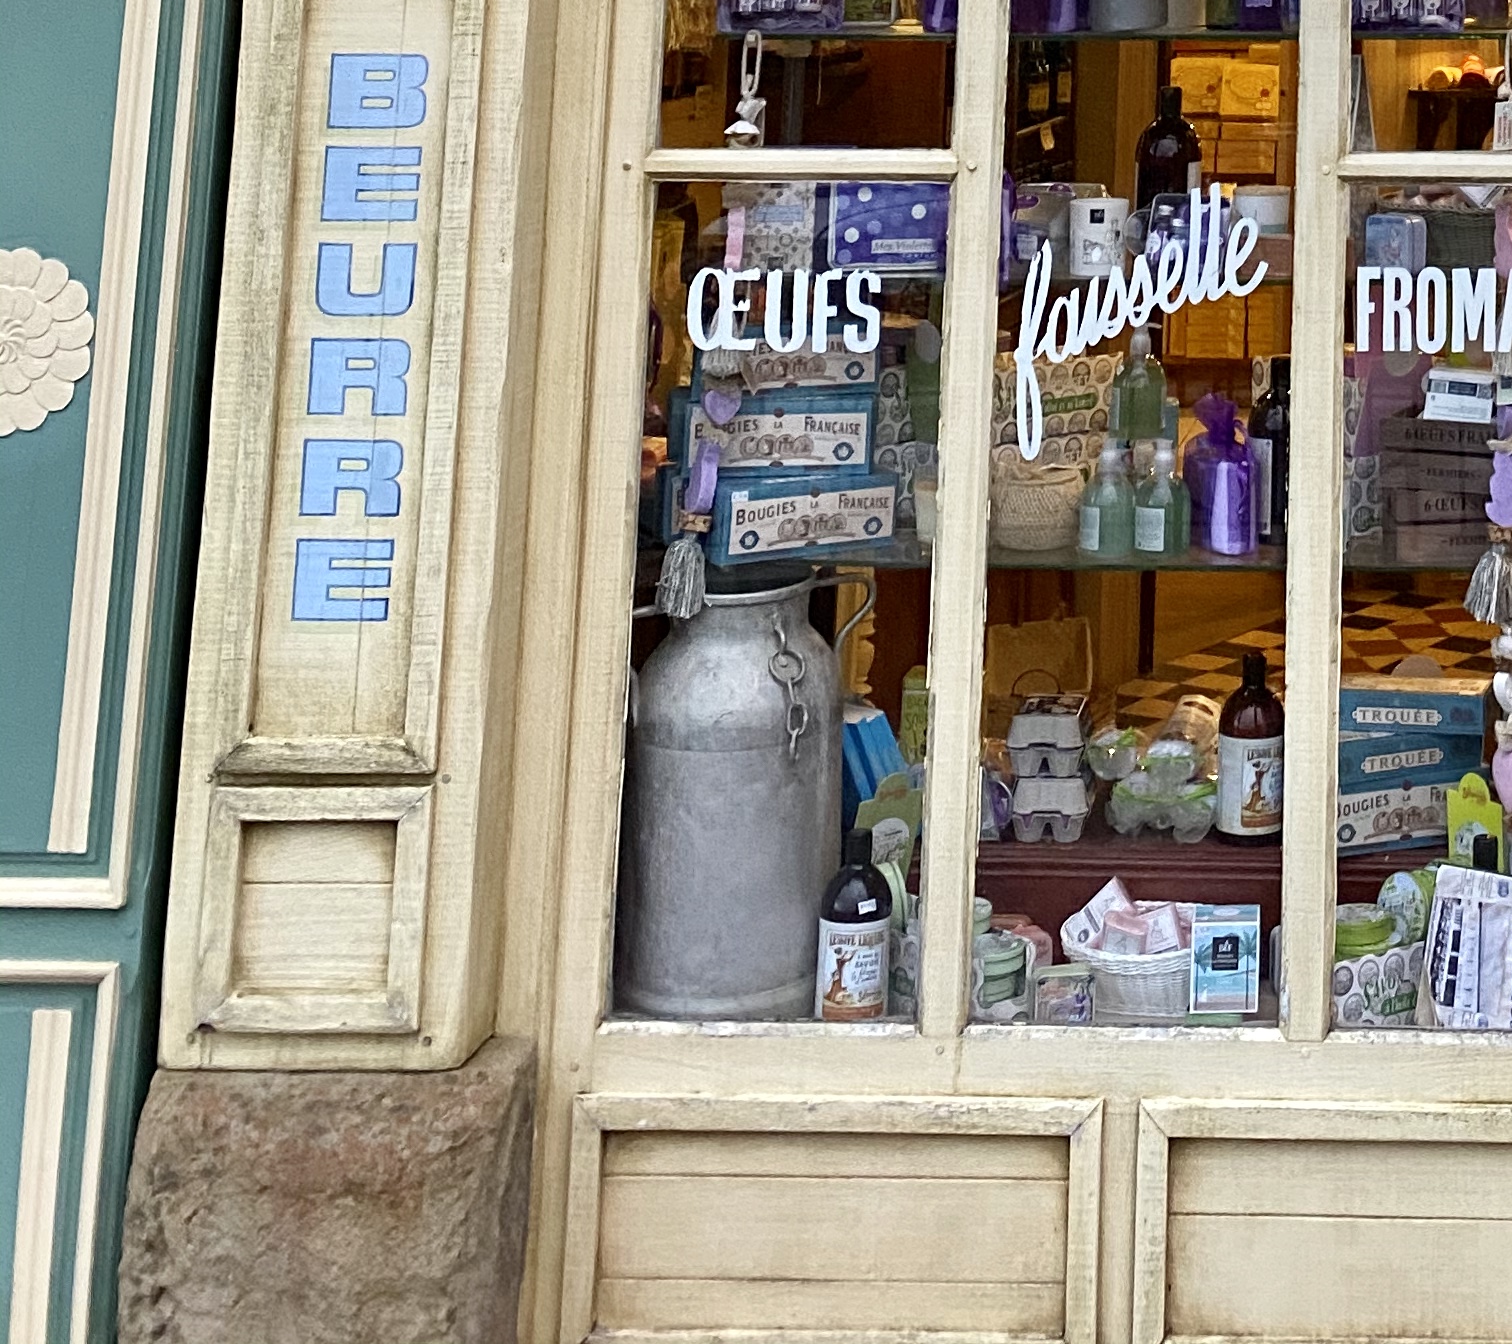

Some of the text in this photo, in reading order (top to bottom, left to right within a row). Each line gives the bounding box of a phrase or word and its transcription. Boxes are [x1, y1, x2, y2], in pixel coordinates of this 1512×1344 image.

[291, 52, 430, 623] BEURRE
[687, 267, 882, 354] ŒUFS
[736, 500, 796, 526] BOUGIES
